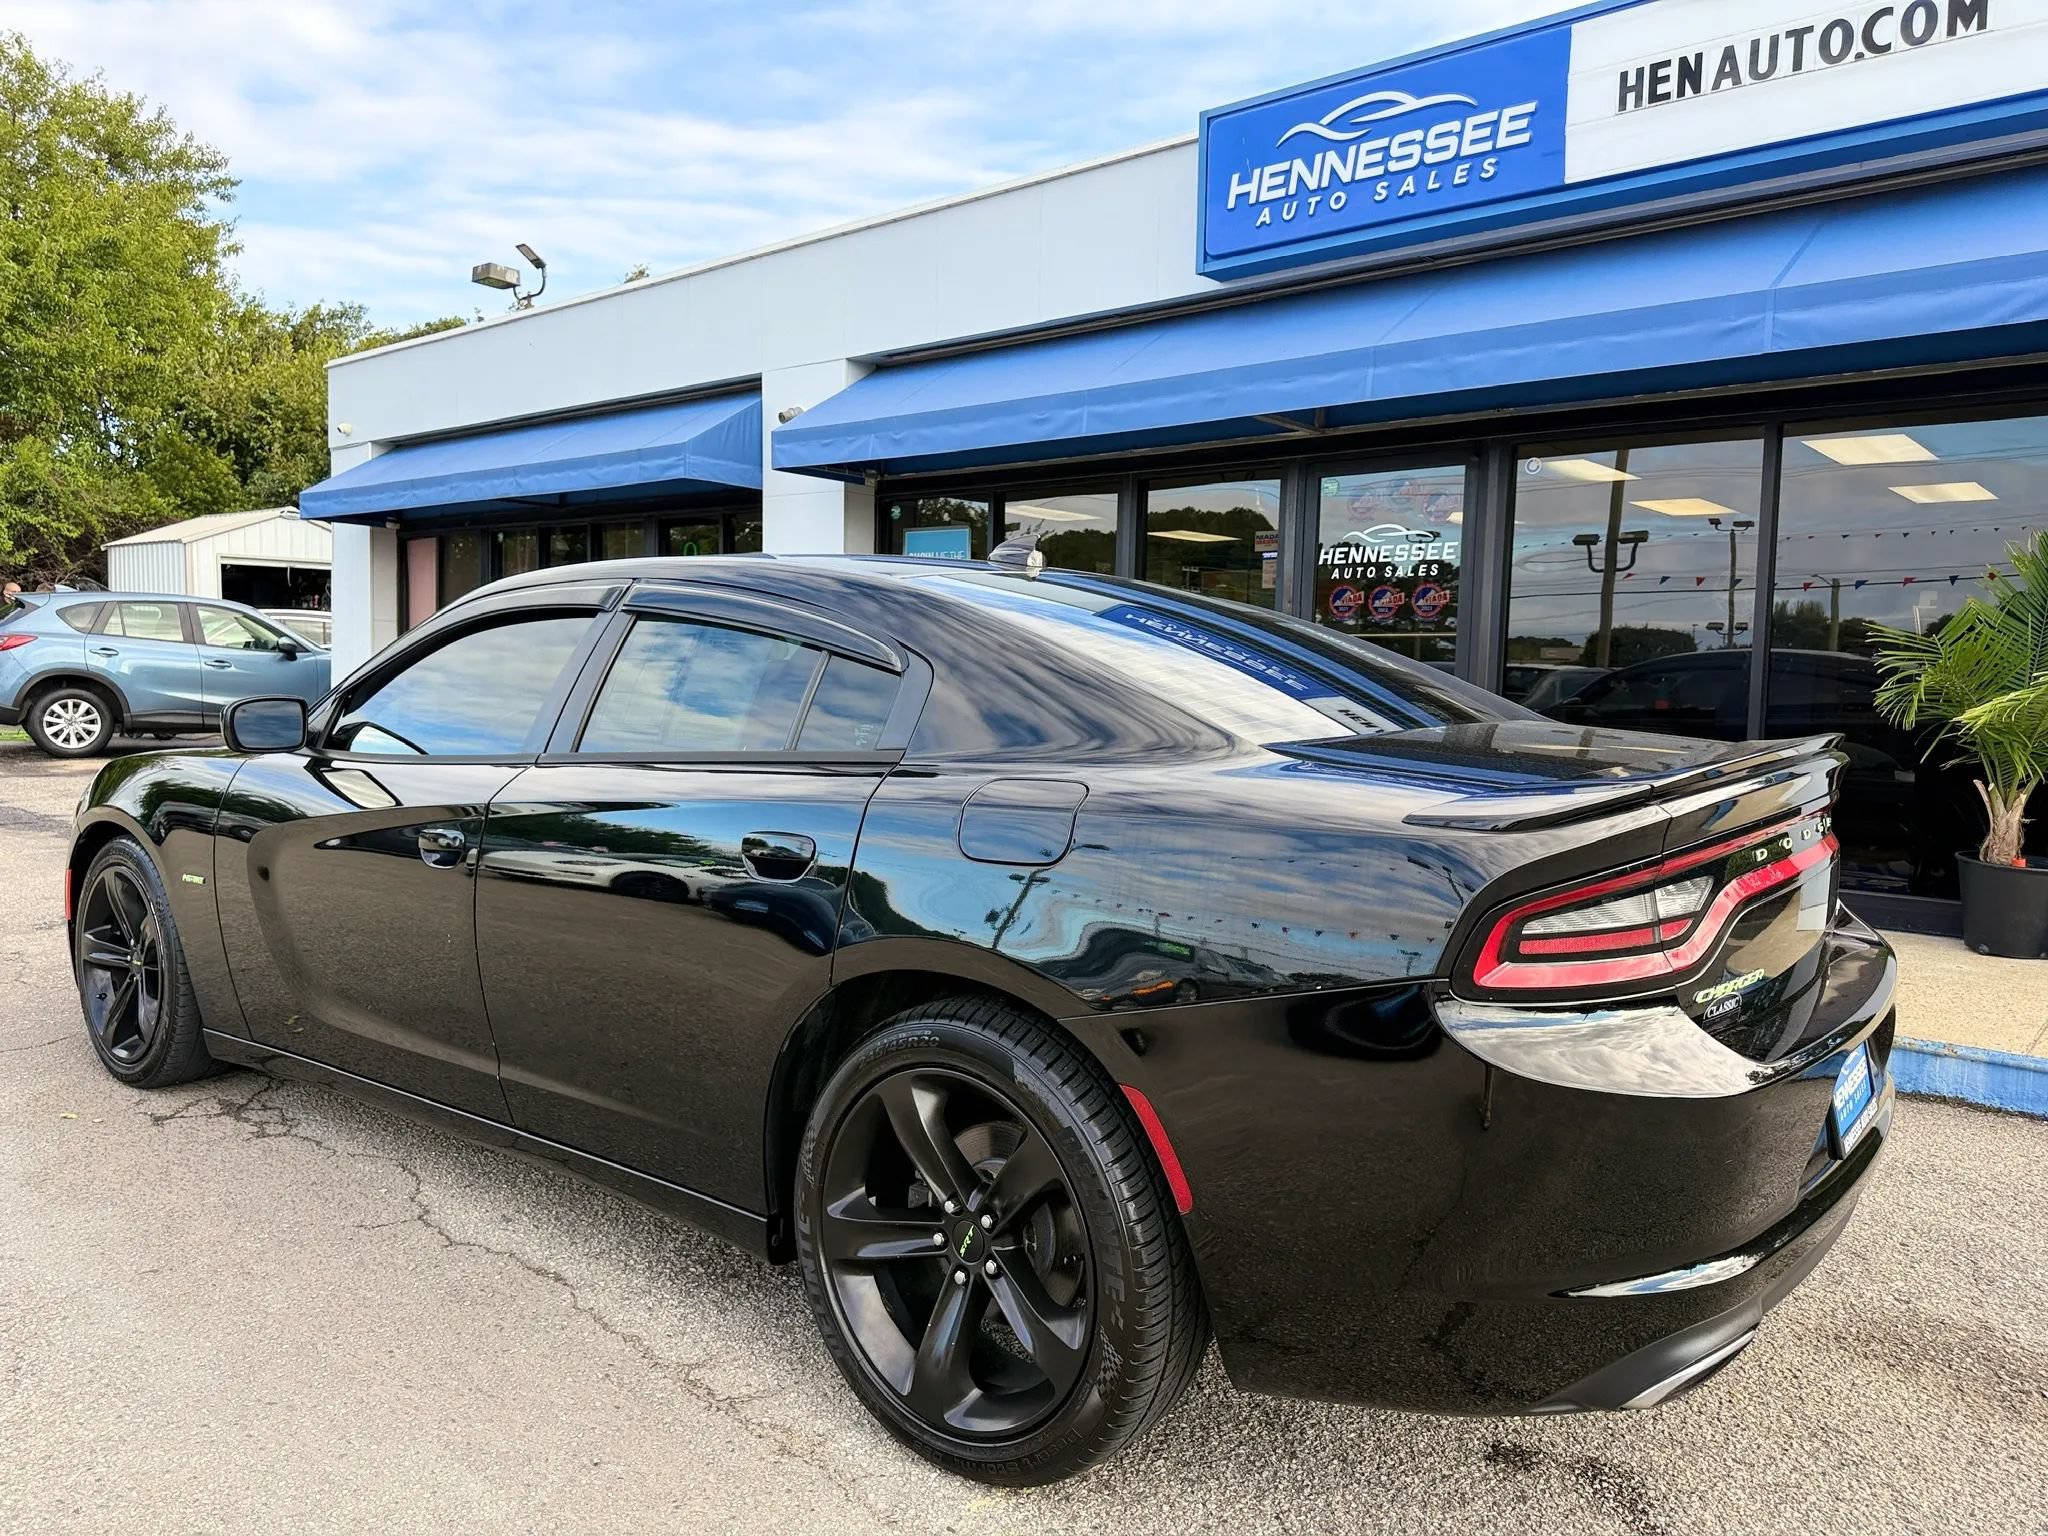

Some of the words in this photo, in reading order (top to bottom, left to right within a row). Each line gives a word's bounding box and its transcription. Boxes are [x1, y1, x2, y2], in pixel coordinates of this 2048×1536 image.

[1618, 0, 1989, 112] HENAUTO.COM
[1227, 101, 1537, 210] HENNESSEE
[1256, 191, 1346, 227] AUTO
[1373, 157, 1498, 201] SALES
[1318, 541, 1459, 566] HENNESSEE
[1331, 566, 1376, 580] AUTO
[1384, 563, 1439, 578] SALES
[1752, 817, 1831, 862] DODGE
[1693, 968, 1765, 1004] CHARGER
[1707, 996, 1740, 1018] CLASSIC
